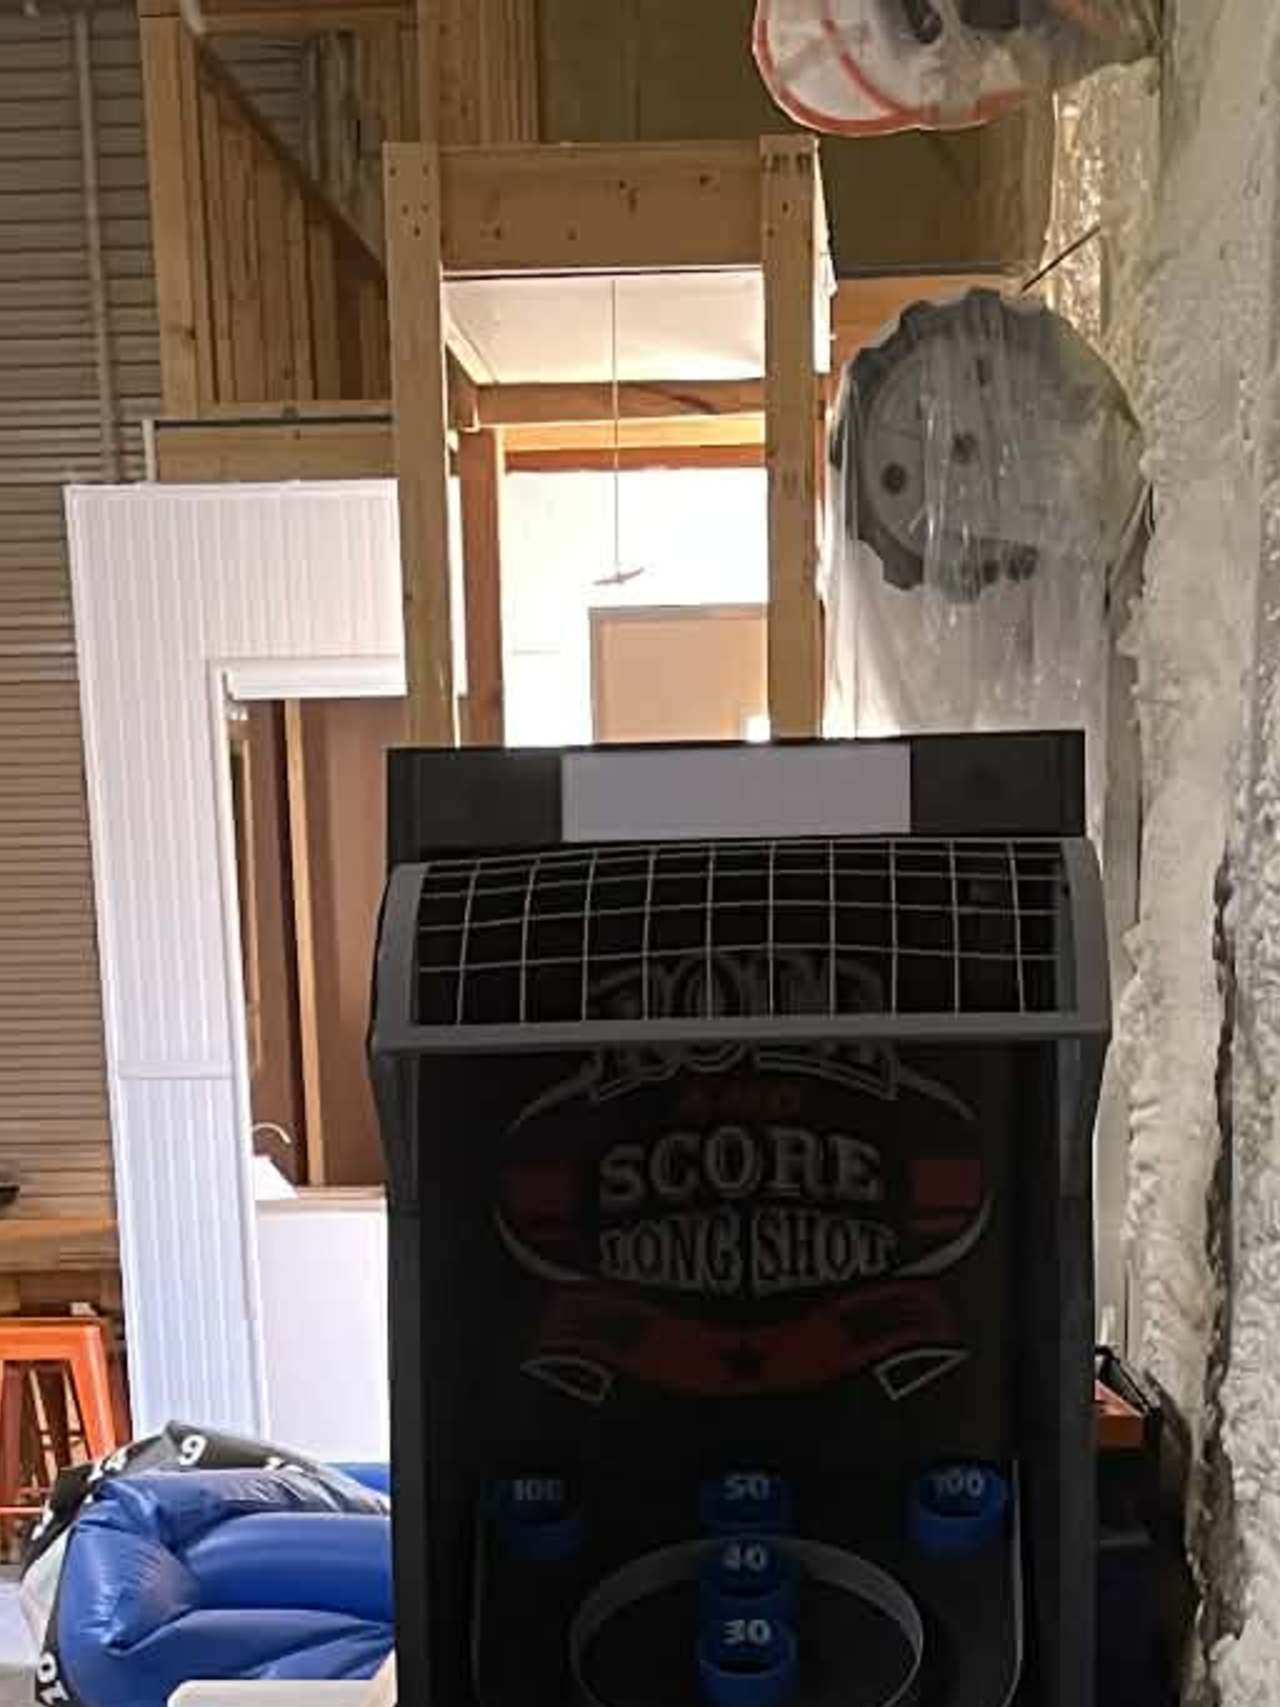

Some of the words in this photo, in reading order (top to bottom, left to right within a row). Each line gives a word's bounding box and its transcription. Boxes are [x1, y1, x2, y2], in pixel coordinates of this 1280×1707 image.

[597, 1125, 882, 1202] SCORE
[599, 1204, 744, 1296] LONG
[751, 1204, 898, 1296] SHOT
[178, 1434, 207, 1466] 9
[512, 1477, 563, 1502] 100
[723, 1474, 771, 1501] 50
[932, 1468, 985, 1498] 100
[723, 1544, 767, 1573] 40
[723, 1618, 772, 1646] 30
